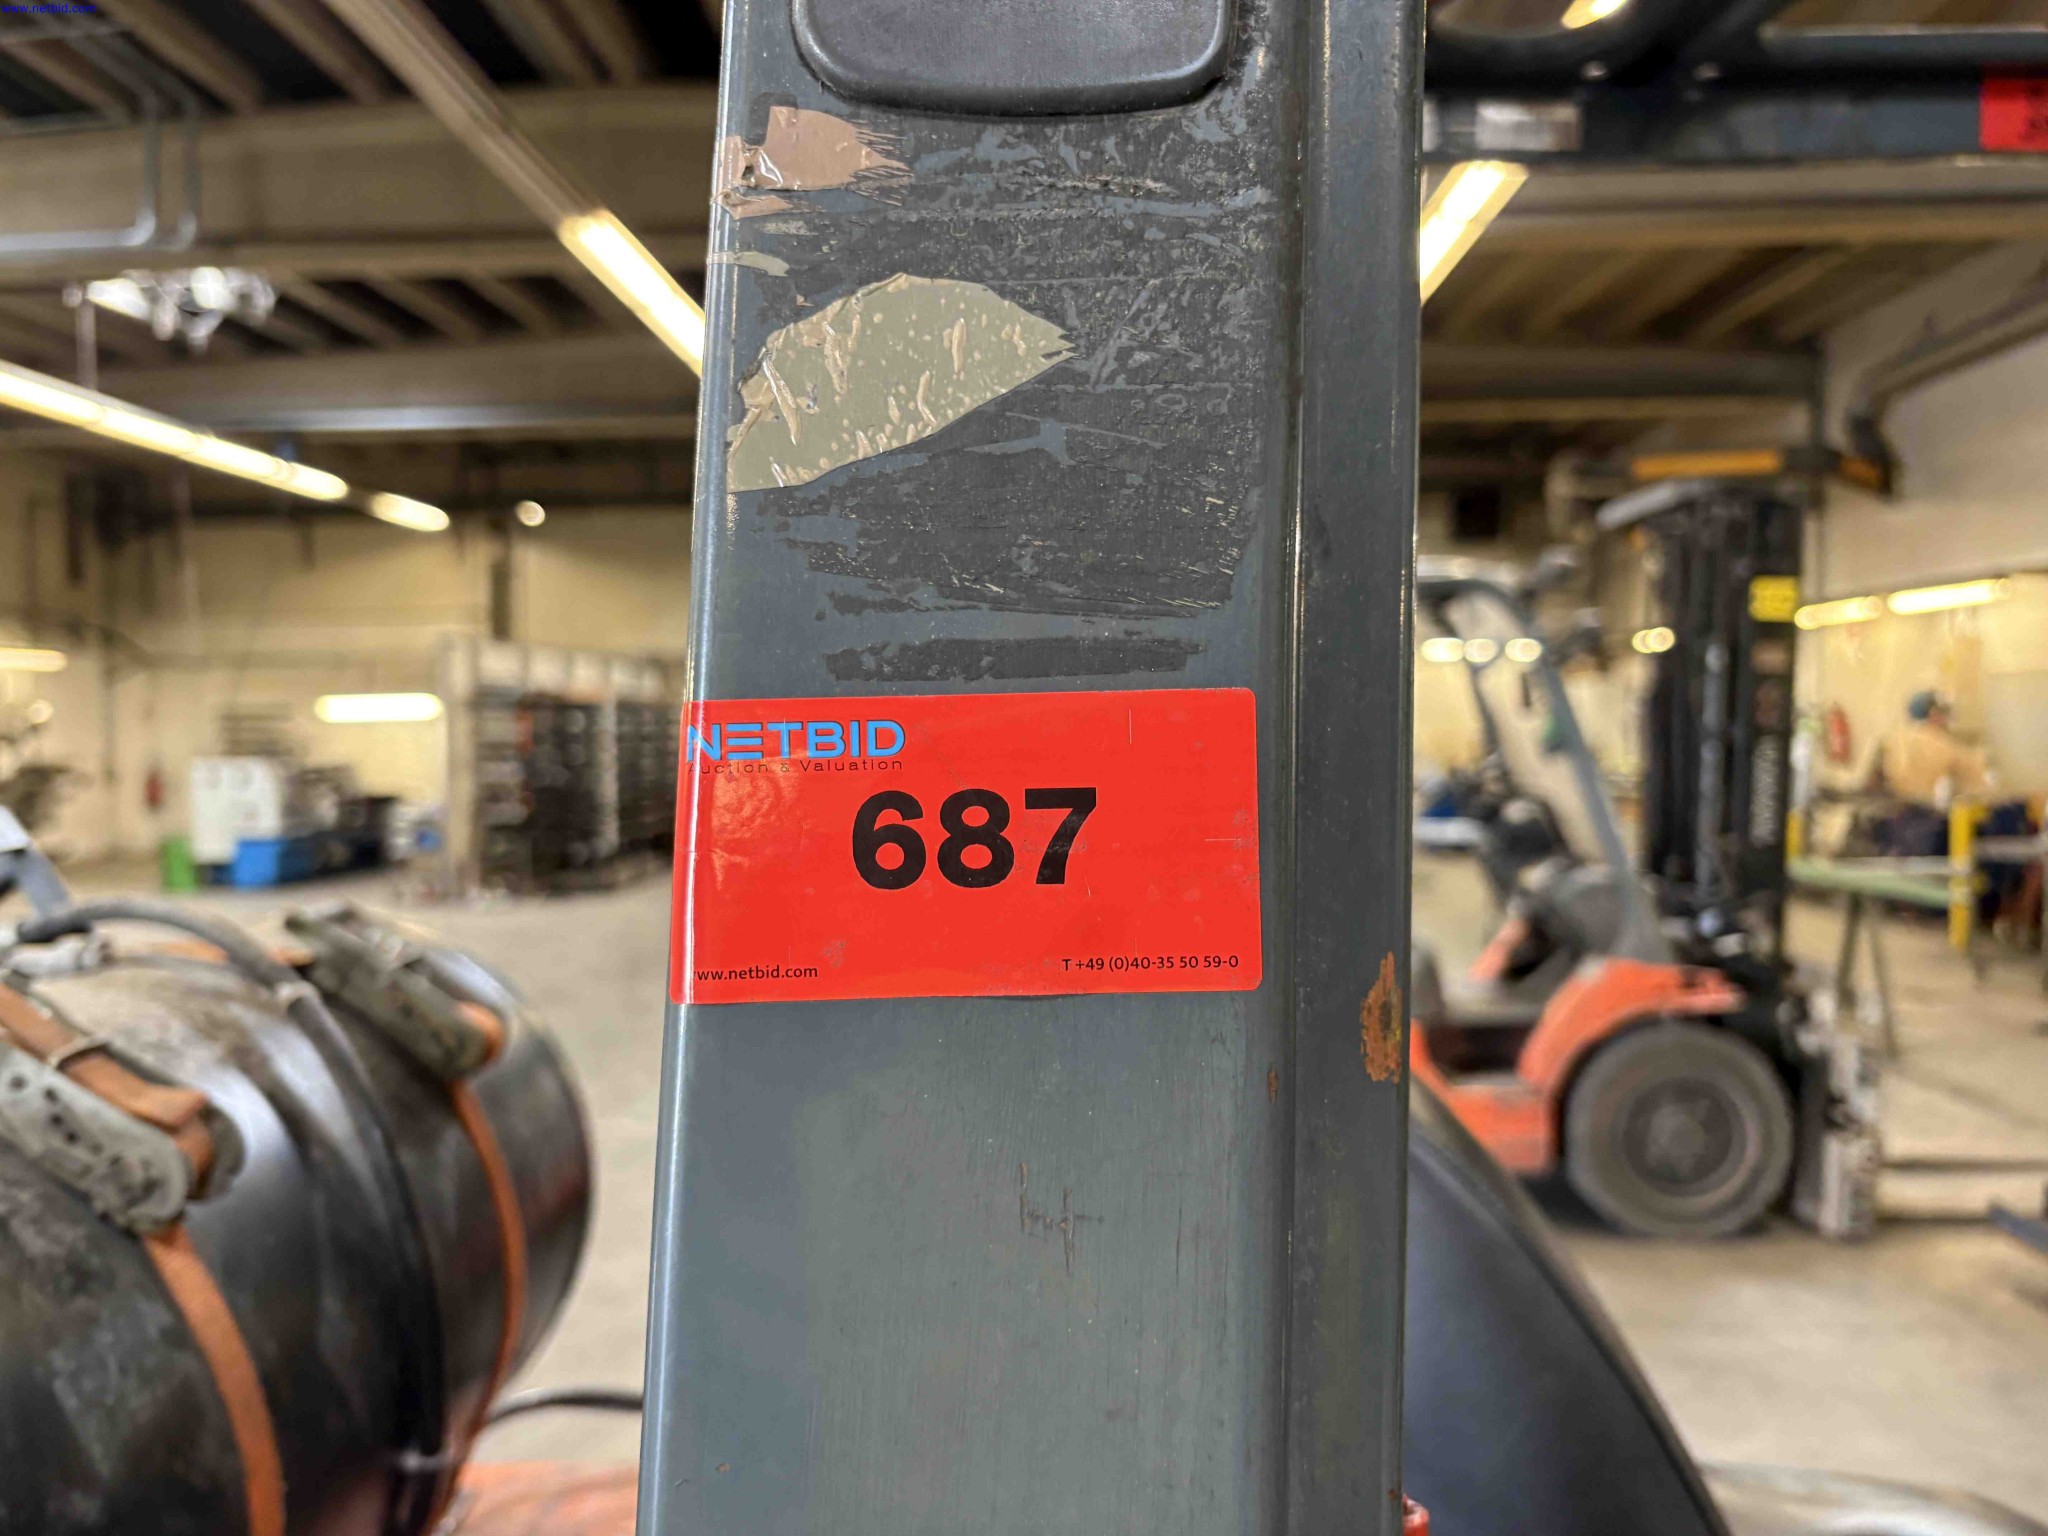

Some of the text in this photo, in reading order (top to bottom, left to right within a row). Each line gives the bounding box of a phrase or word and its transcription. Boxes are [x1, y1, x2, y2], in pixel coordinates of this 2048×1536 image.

[686, 719, 906, 761] NETBID
[687, 759, 903, 774] Auction & Valuation
[852, 787, 1097, 891] 687
[1062, 955, 1239, 972] T +49 (0)40-35 50 59-0
